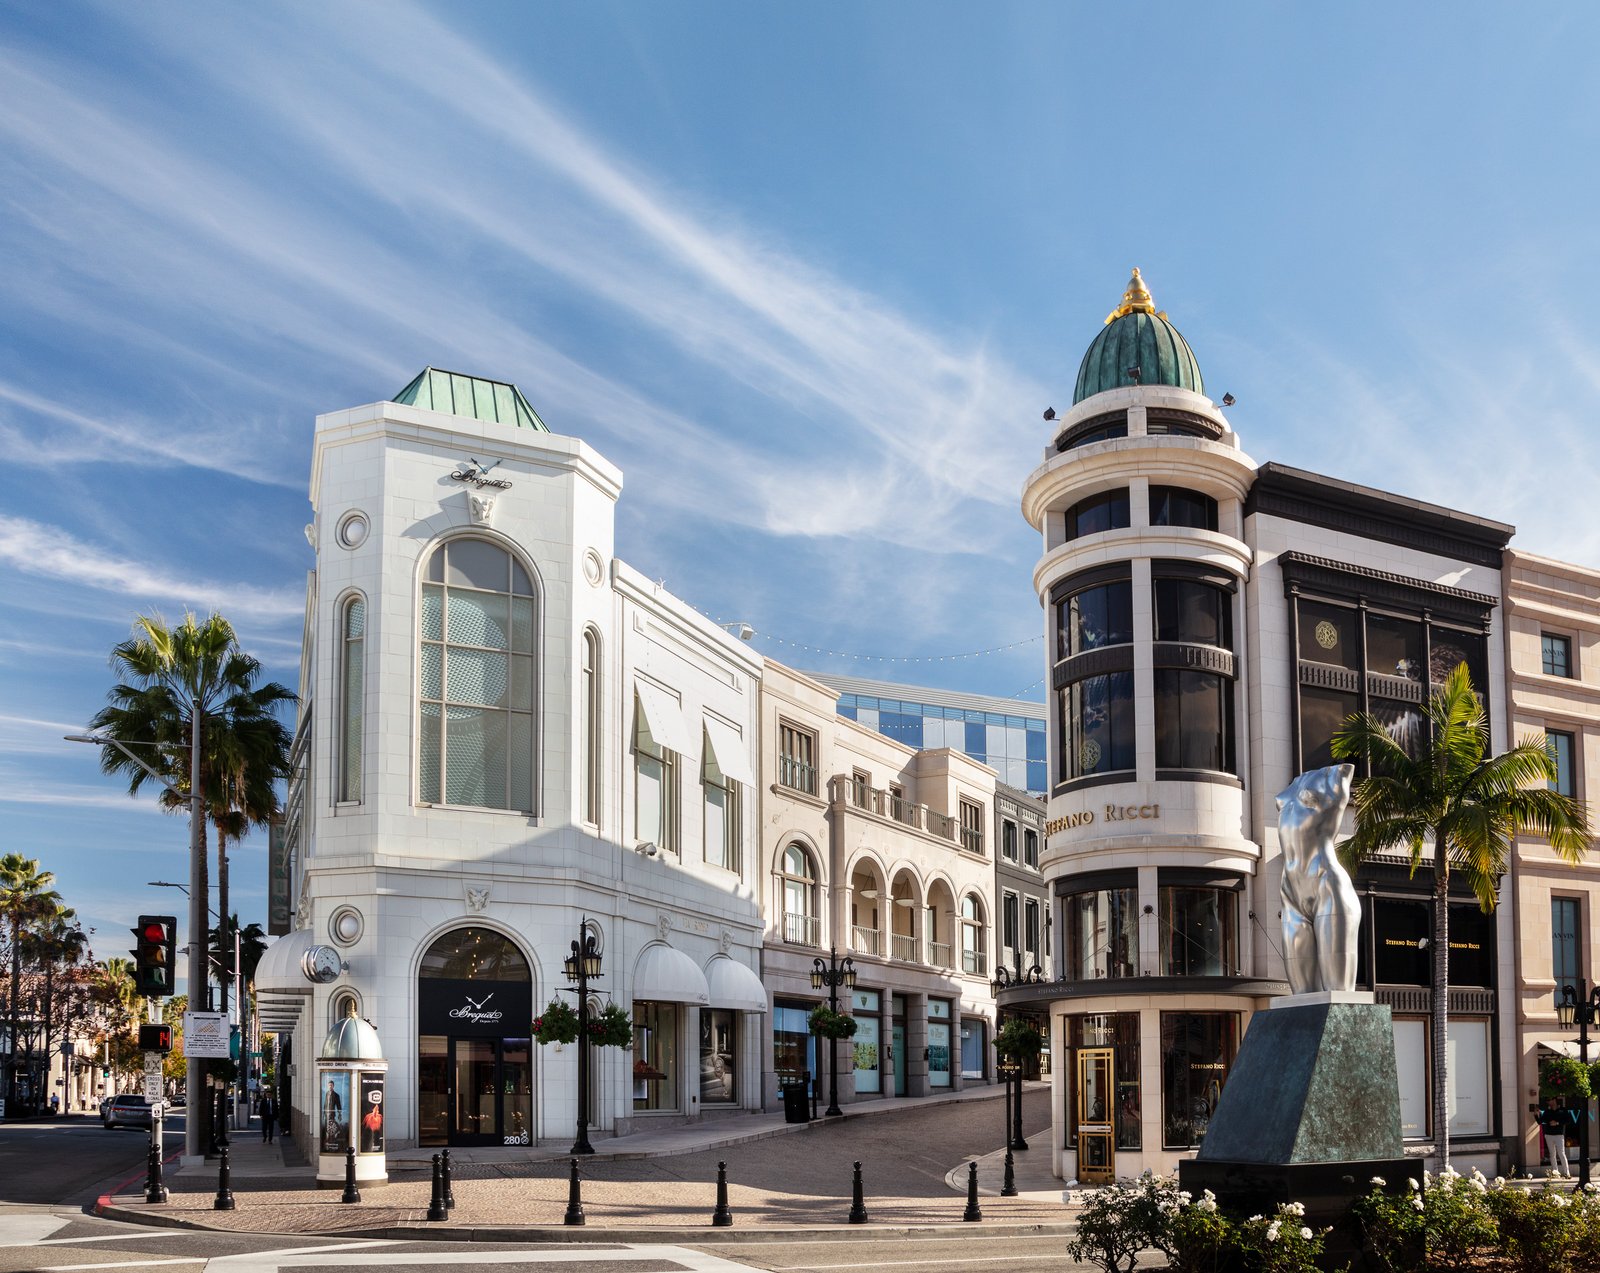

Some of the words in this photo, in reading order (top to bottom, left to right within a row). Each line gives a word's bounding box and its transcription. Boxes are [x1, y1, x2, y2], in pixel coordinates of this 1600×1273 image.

[451, 469, 512, 489] Breguet
[1104, 804, 1160, 822] RICCI
[449, 1005, 503, 1023] Breguet
[160, 1031, 170, 1046] 14
[504, 1135, 520, 1145] 280
